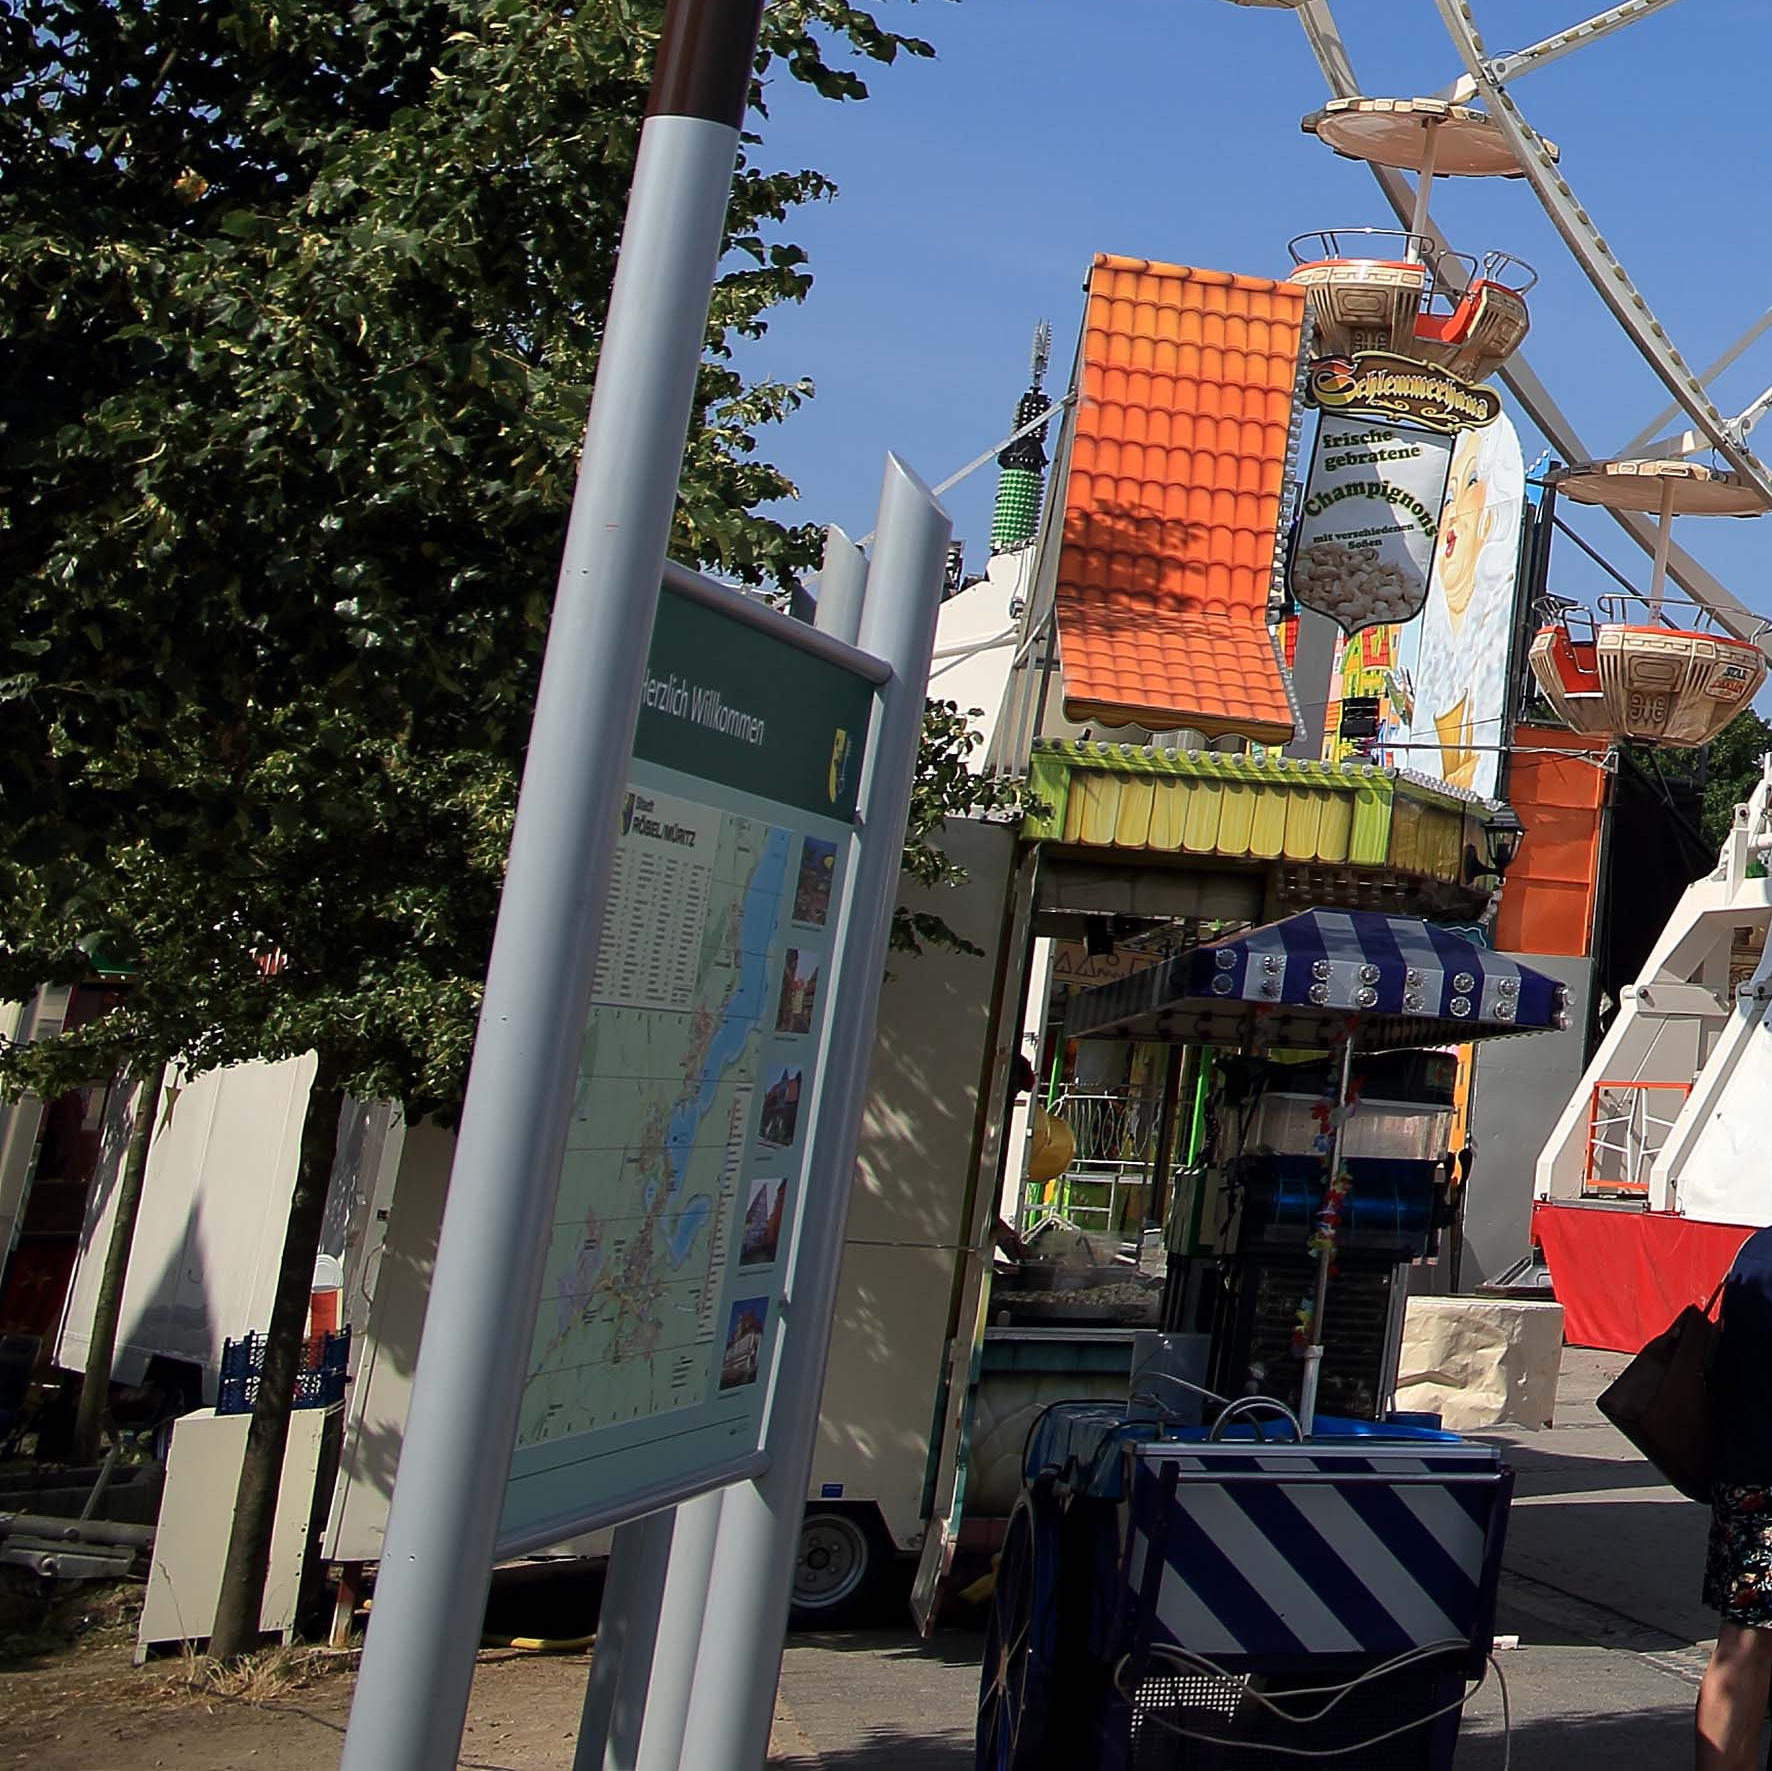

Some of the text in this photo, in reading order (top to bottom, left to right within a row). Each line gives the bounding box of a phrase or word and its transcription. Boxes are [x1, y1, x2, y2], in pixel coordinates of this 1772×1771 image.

[1312, 359, 1488, 421] Schlemmerhaus
[1322, 429, 1394, 449] frische
[1324, 446, 1421, 472] gebratene
[1304, 480, 1438, 537] Champignons
[1313, 523, 1415, 544] mit verschiedenen
[1348, 538, 1383, 550] Soßen
[690, 685, 764, 746] Willkommen
